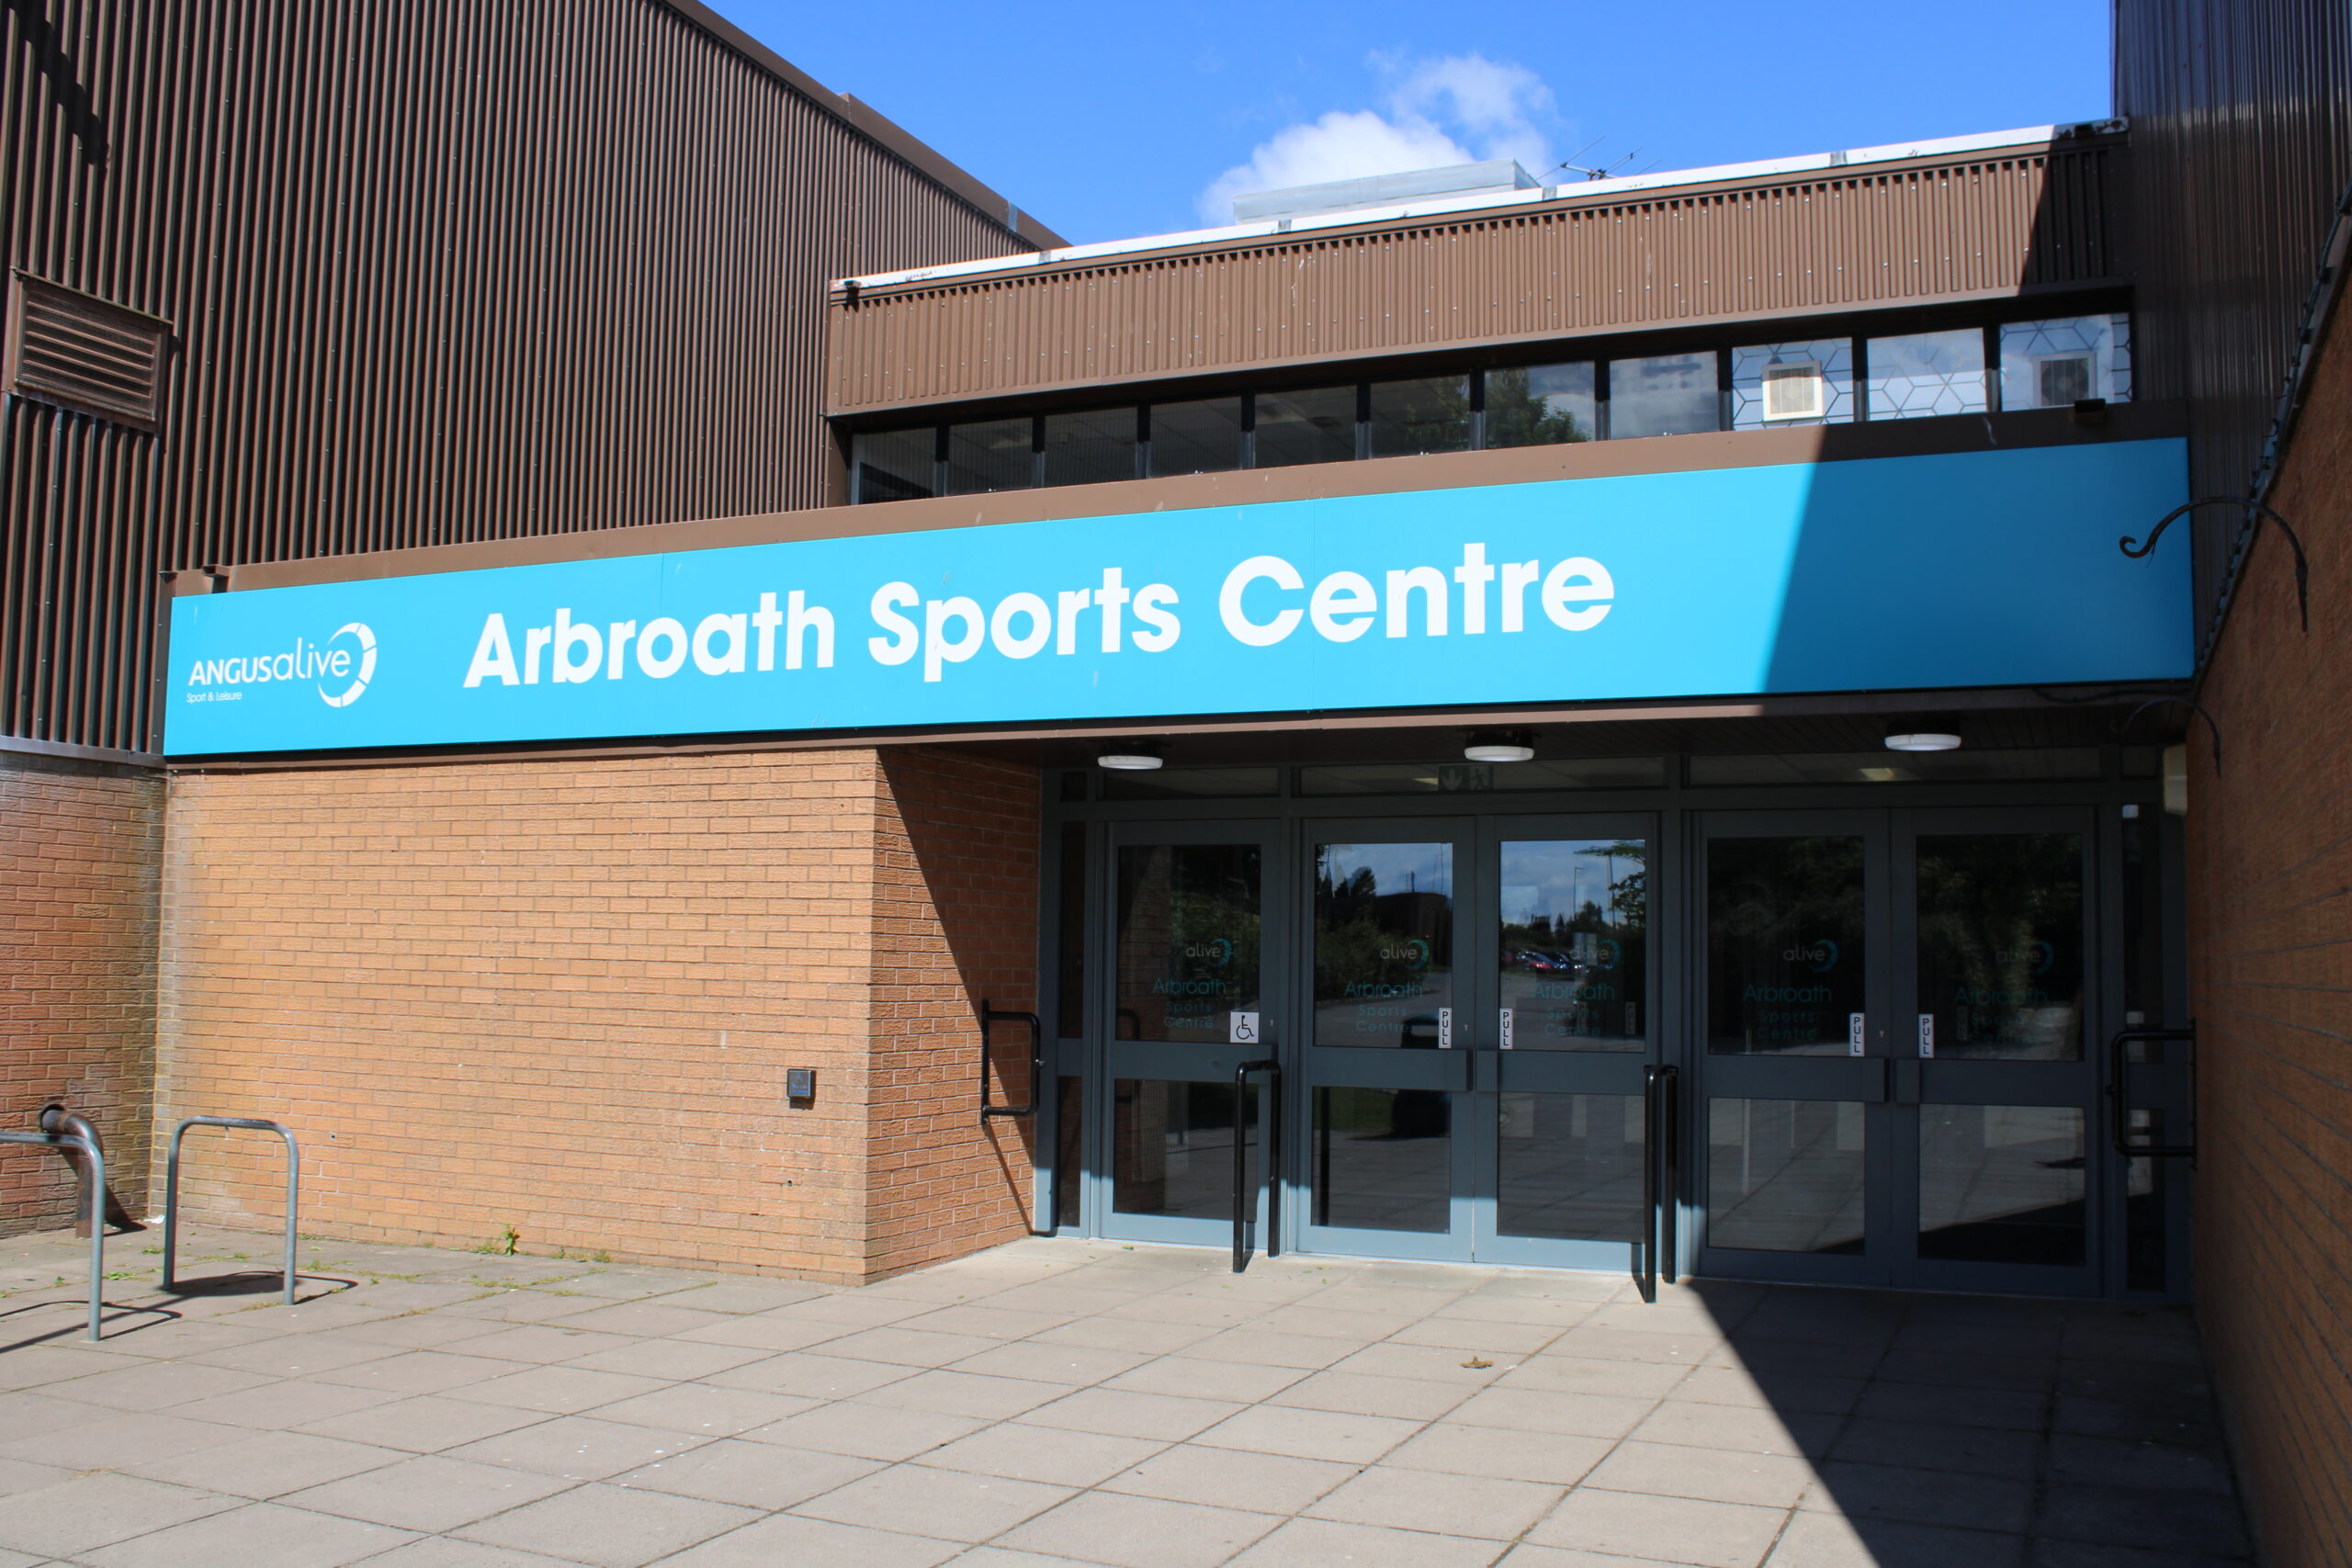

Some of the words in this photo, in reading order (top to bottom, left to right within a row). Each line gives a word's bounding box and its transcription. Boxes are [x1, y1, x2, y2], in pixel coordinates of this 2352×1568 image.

[463, 583, 836, 689] Arbroath
[869, 568, 1182, 683] Sports
[1219, 542, 1615, 647] Centre
[187, 693, 207, 705] Sport
[208, 692, 214, 701] &
[216, 691, 243, 701] Leisure
[1185, 942, 1221, 957] alive
[1380, 942, 1418, 960] alive
[1782, 942, 1826, 962] alive
[1152, 976, 1227, 995] Arbroath
[1344, 979, 1423, 998] Arbroath
[1742, 984, 1834, 1002] Arbroath
[1358, 1004, 1409, 1018] Sports
[1757, 1009, 1816, 1023] Sports
[1853, 1016, 1861, 1054] PULL
[1922, 1018, 1930, 1055] PULL
